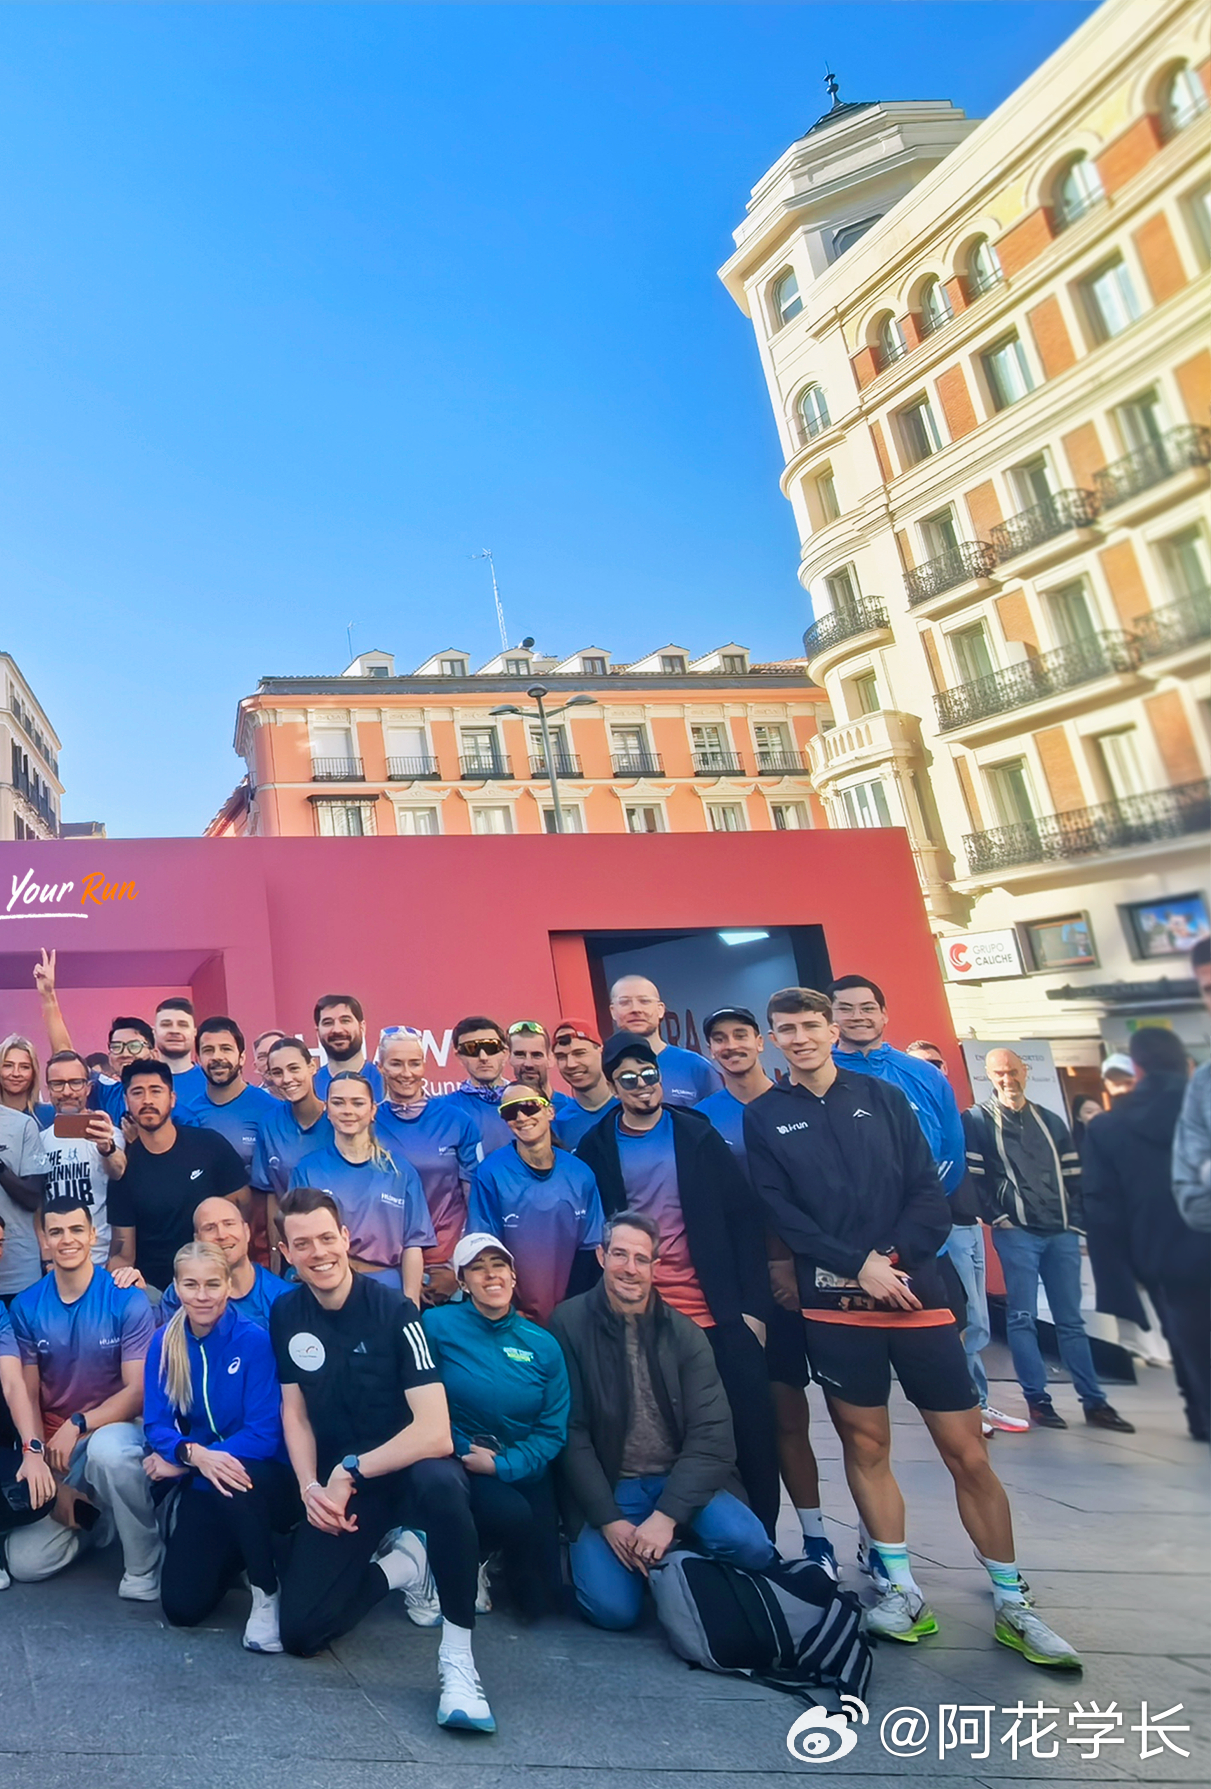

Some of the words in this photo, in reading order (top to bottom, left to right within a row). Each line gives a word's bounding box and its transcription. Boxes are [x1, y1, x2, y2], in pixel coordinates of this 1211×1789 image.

[6, 868, 75, 912] Your
[80, 872, 140, 905] Run
[972, 943, 1004, 954] GRUPO
[975, 954, 1014, 966] CALICHE
